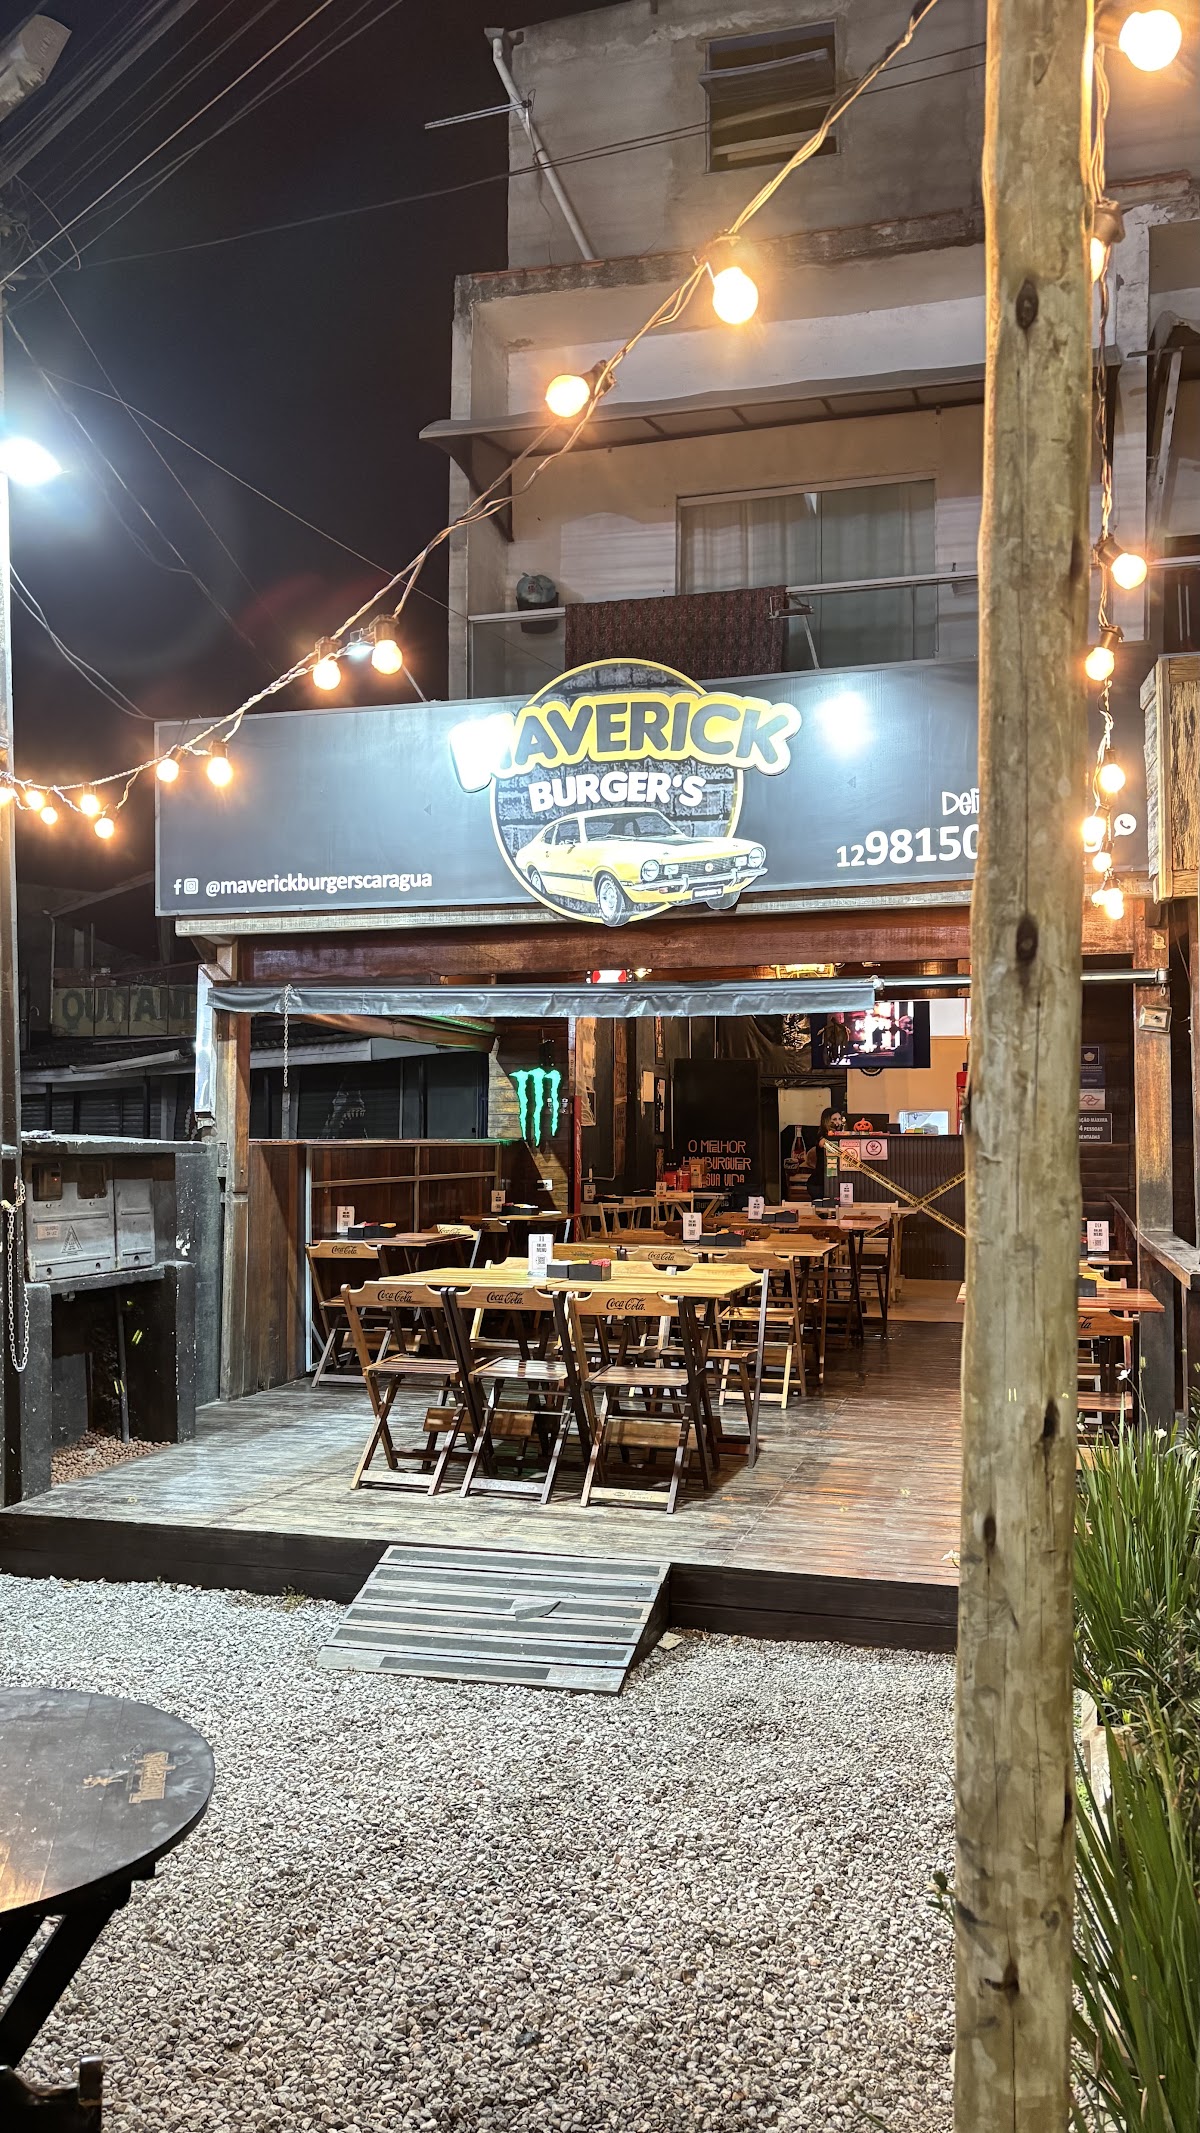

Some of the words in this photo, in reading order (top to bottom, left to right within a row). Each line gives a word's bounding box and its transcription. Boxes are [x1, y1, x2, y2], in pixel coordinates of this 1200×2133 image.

[456, 699, 792, 783] AVERICK
[205, 872, 433, 898] @maverickburgerscaragua
[687, 1139, 698, 1153] O
[700, 1139, 747, 1154] MELHOR
